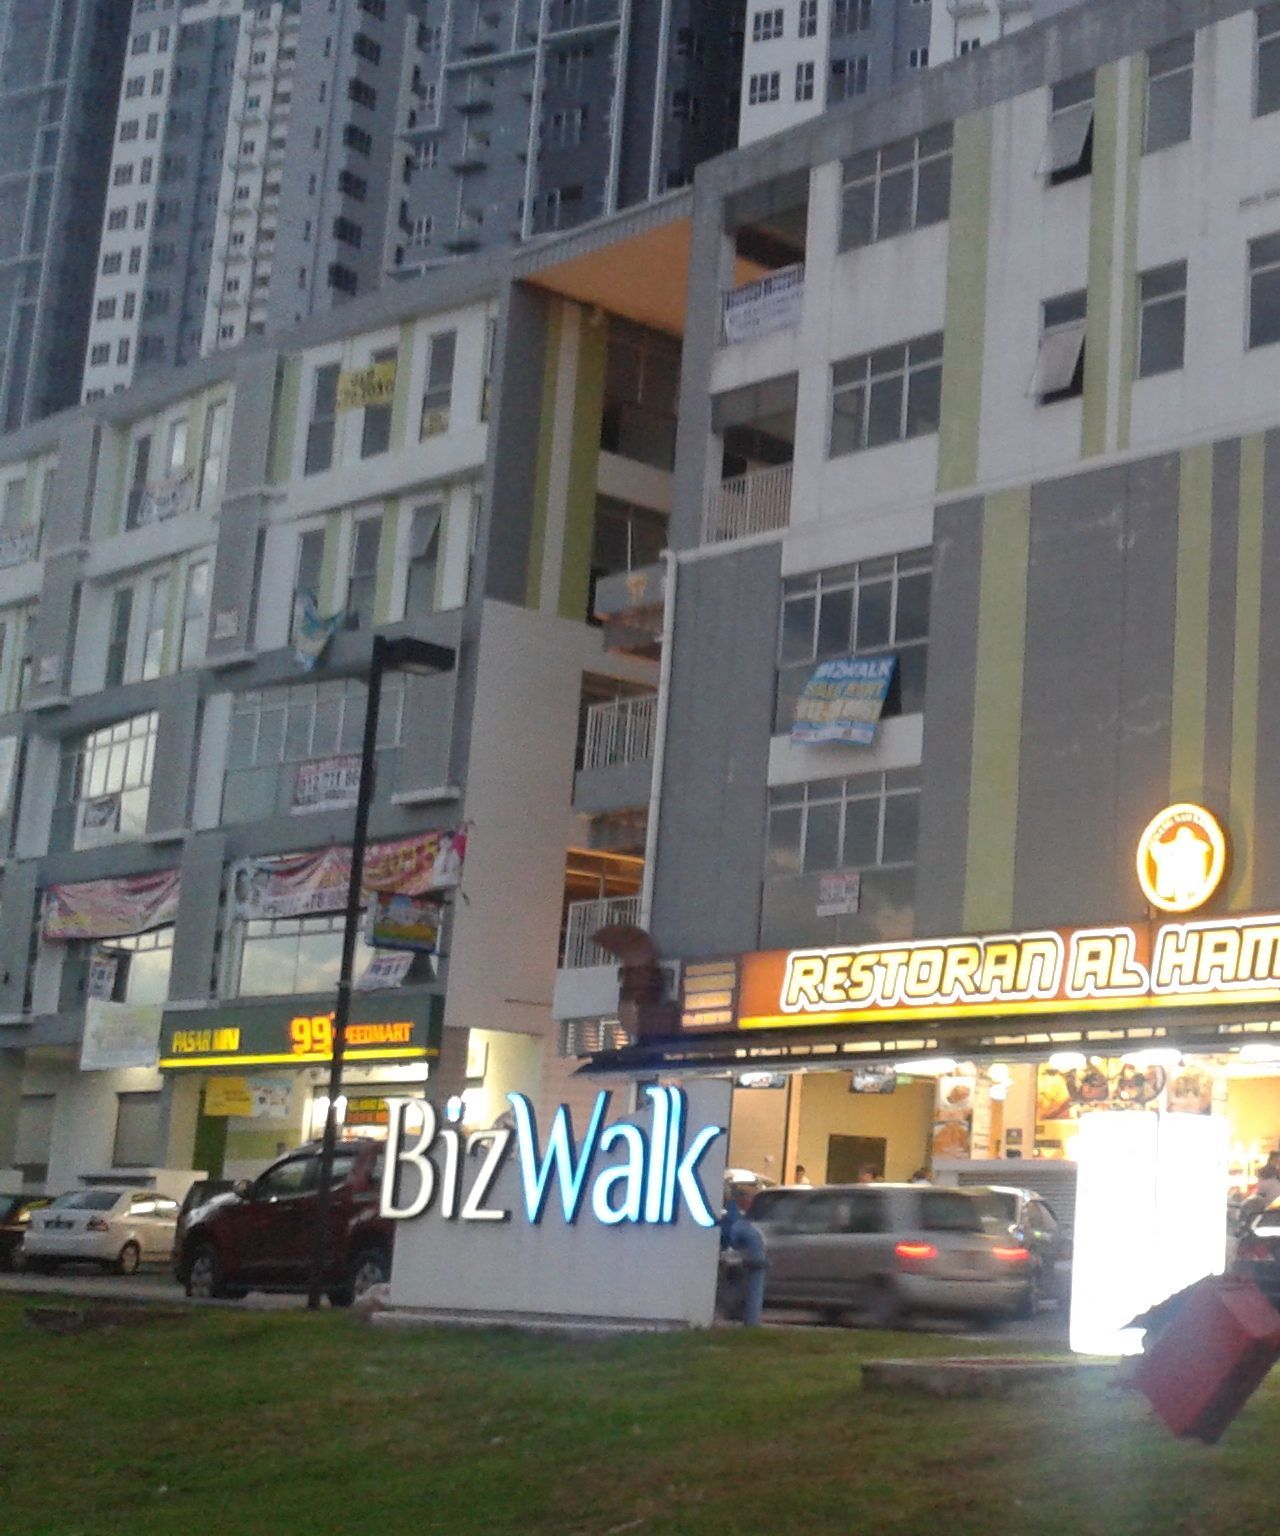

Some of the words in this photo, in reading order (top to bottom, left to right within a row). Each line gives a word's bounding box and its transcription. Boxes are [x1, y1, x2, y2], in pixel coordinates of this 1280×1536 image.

[784, 936, 1059, 1006] RESTORAN
[1071, 932, 1144, 990] AL
[172, 1029, 211, 1053] PASAR
[290, 1015, 334, 1054] 99
[332, 1021, 413, 1045] EEDMART
[380, 1086, 720, 1227] BizWalk
